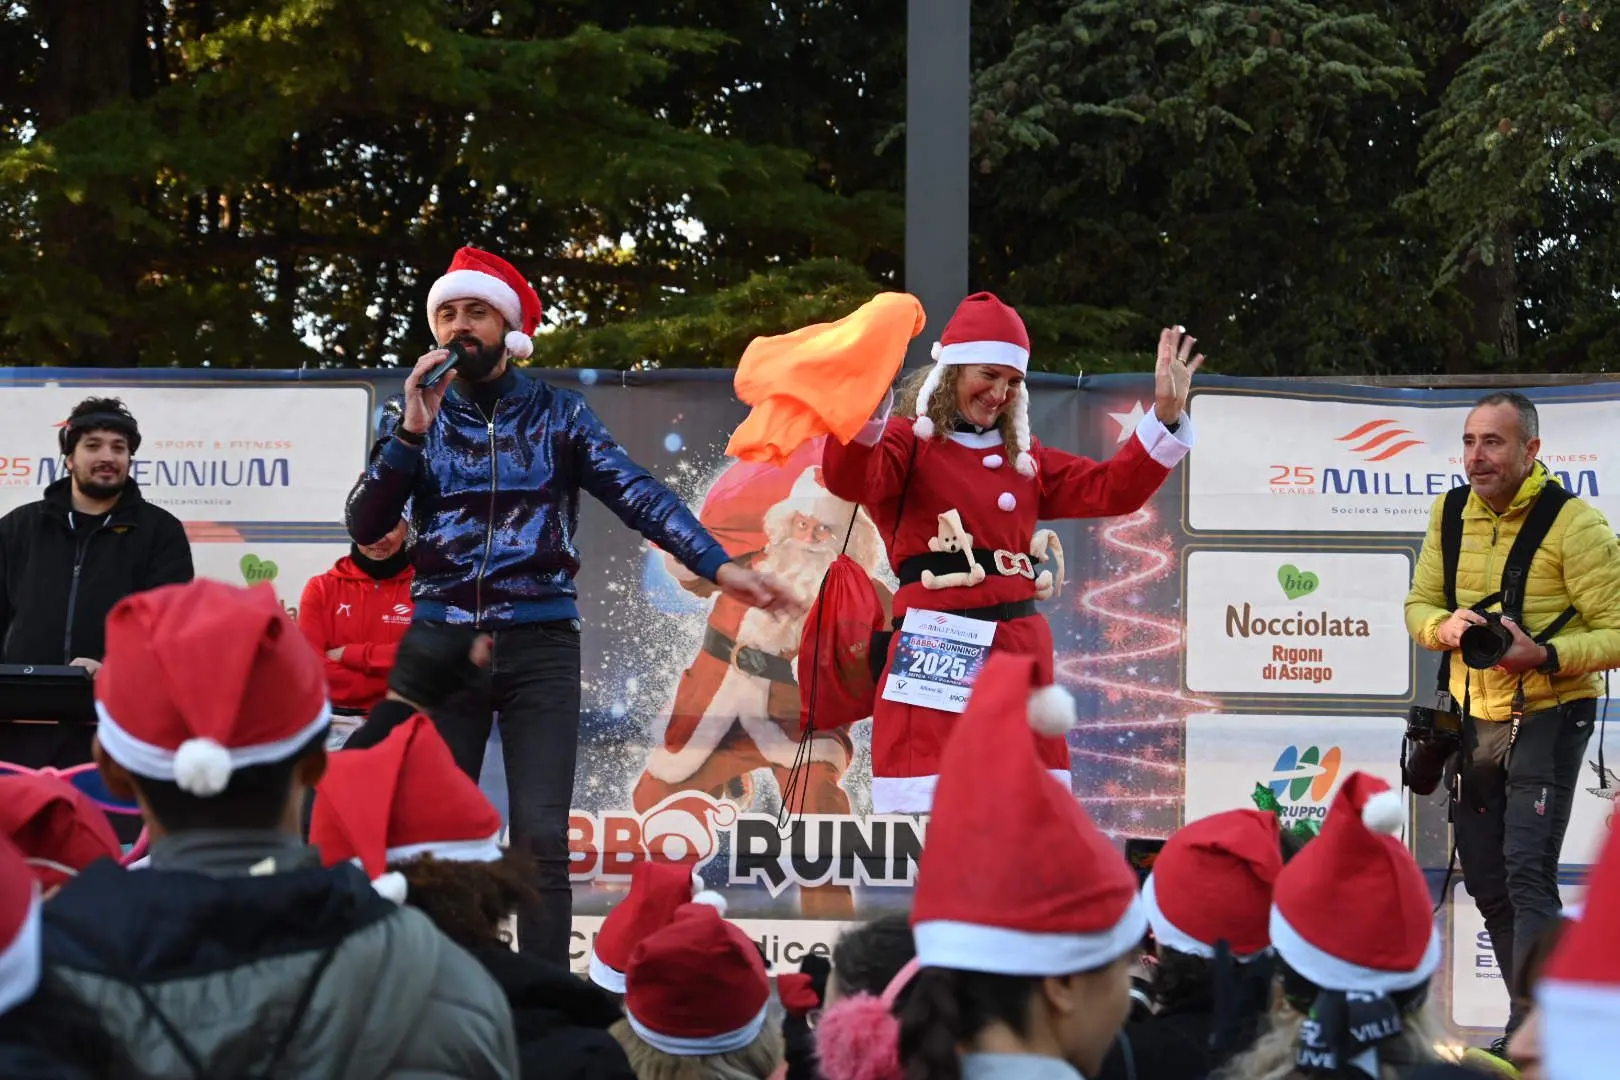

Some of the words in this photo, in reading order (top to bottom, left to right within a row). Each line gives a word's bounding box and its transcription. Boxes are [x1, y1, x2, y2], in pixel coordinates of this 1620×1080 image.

[154, 440, 205, 449] SPORT
[229, 440, 293, 449] FITNESS
[1270, 465, 1315, 485] 25
[1321, 468, 1599, 496] MILLENM
[1270, 487, 1315, 495] YEARS
[1384, 507, 1431, 516] Sportiv
[1284, 574, 1315, 592] bio
[1225, 602, 1370, 638] Nocciolata
[940, 642, 977, 657] RUNNING
[1272, 645, 1323, 664] Rigoni
[908, 651, 967, 680] 2025
[1262, 664, 1277, 680] di
[1279, 664, 1332, 683] Asiago
[1281, 806, 1328, 818] RUPPO
[568, 797, 713, 876] BBO
[735, 819, 925, 889] RUNN
